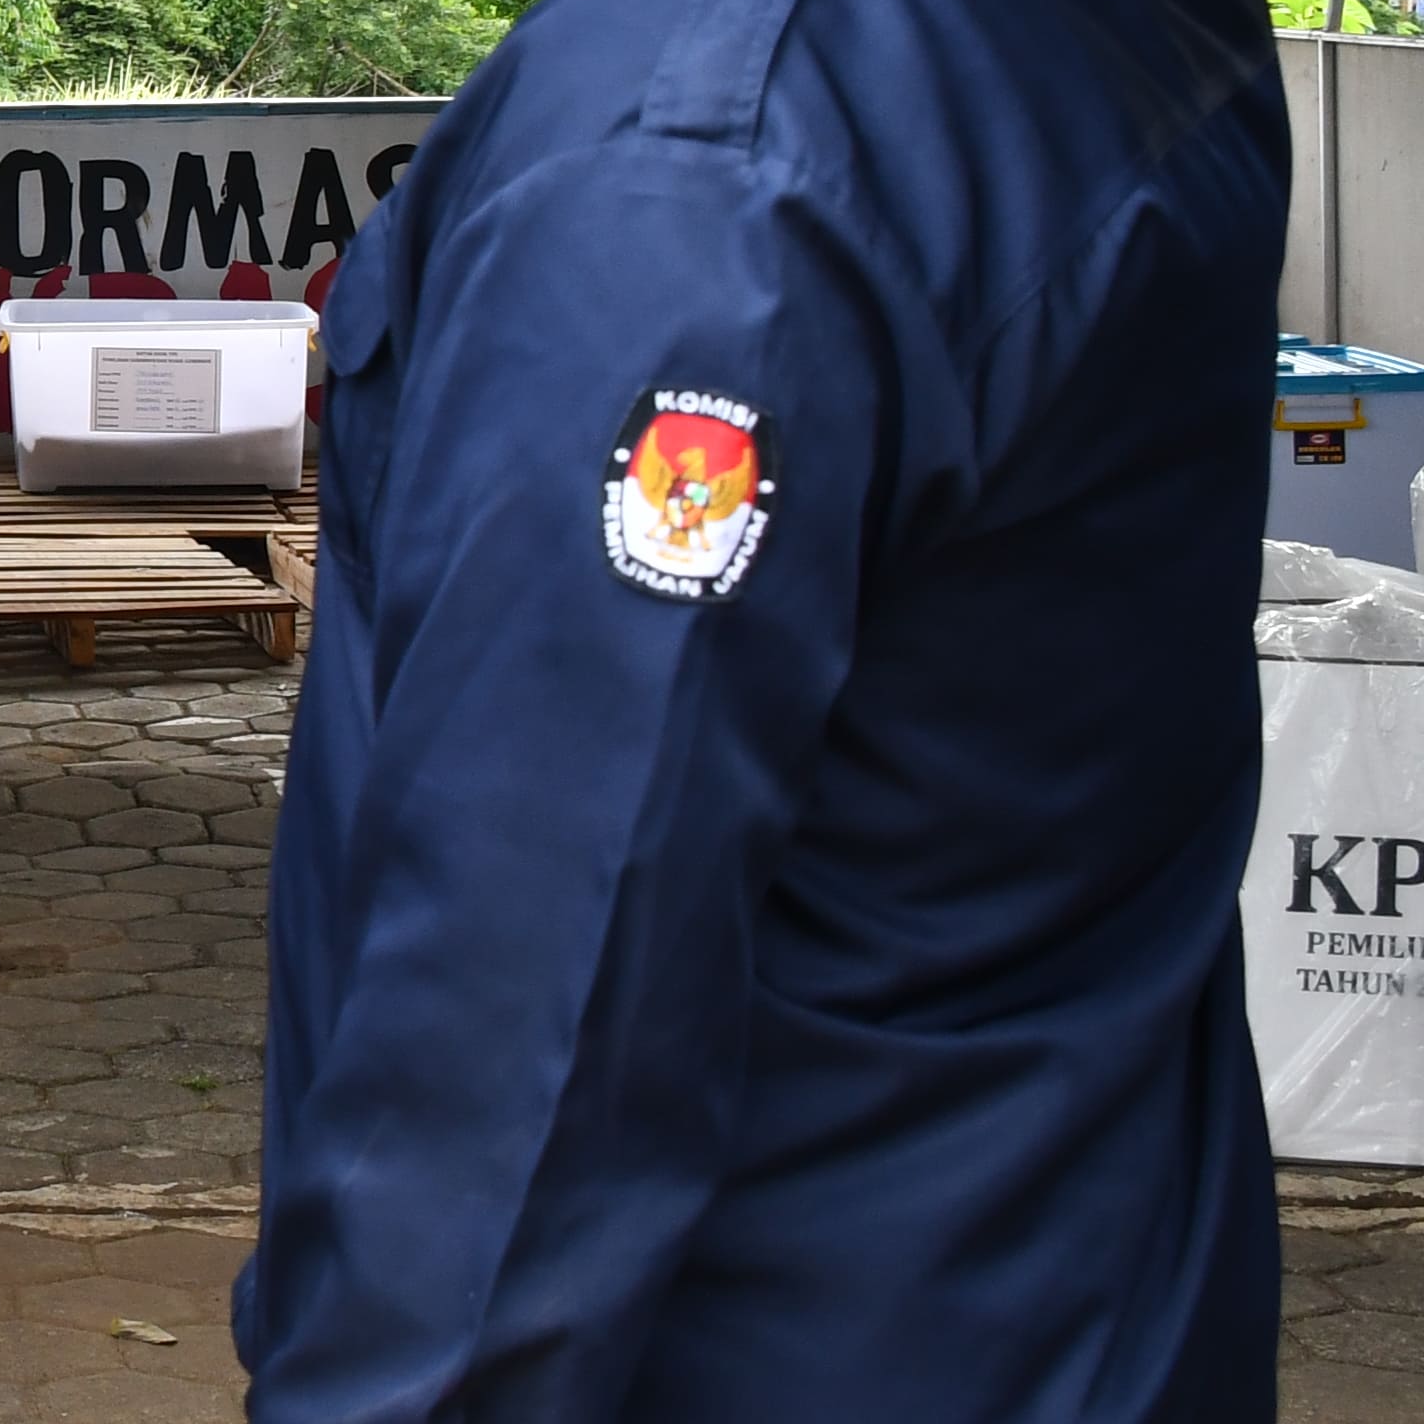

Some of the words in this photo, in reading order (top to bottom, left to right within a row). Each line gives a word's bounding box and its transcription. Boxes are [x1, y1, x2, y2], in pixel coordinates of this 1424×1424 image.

[654, 390, 759, 431] KOMISI
[1306, 931, 1424, 959] PEMILI
[1296, 968, 1406, 996] TAHUN
